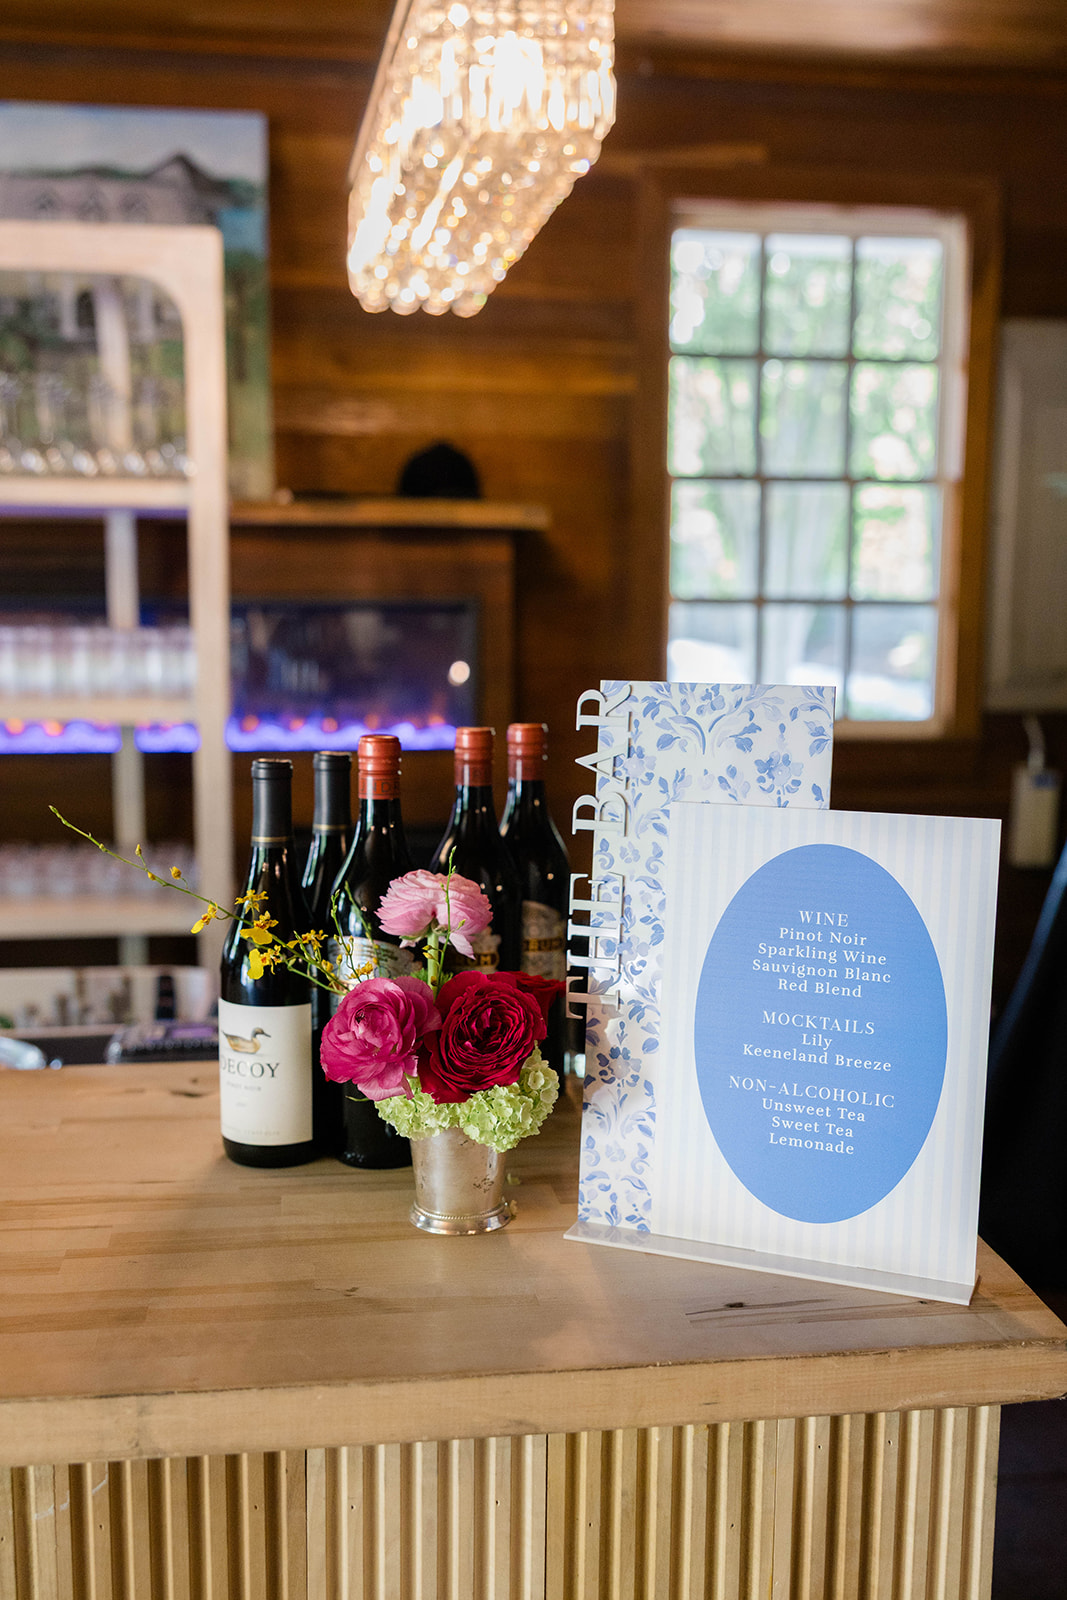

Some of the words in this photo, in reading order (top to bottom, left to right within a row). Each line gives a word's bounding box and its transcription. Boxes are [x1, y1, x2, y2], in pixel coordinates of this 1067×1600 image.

[572, 685, 633, 837] BAR
[798, 910, 849, 928] WINE
[565, 871, 626, 1020] THE
[779, 927, 823, 943] Pinot
[829, 931, 868, 946] Noir
[757, 942, 838, 965] Sparkling
[842, 949, 888, 966] Wine
[752, 958, 838, 979] Sauvignon
[844, 967, 892, 984] Blanc
[777, 978, 809, 993] Red
[814, 981, 863, 998] Blend
[762, 1010, 875, 1035] MOCKTAILS
[801, 1033, 833, 1051] Lily
[742, 1043, 829, 1065] Keeneland
[834, 1053, 892, 1072] Breeze
[729, 1075, 896, 1109] NON-ALCOHOLIC
[761, 1097, 832, 1118] Unsweet
[836, 1107, 866, 1123] Tea
[771, 1115, 820, 1134] Sweet
[824, 1122, 854, 1138] Tea
[768, 1132, 855, 1155] Lemonade
